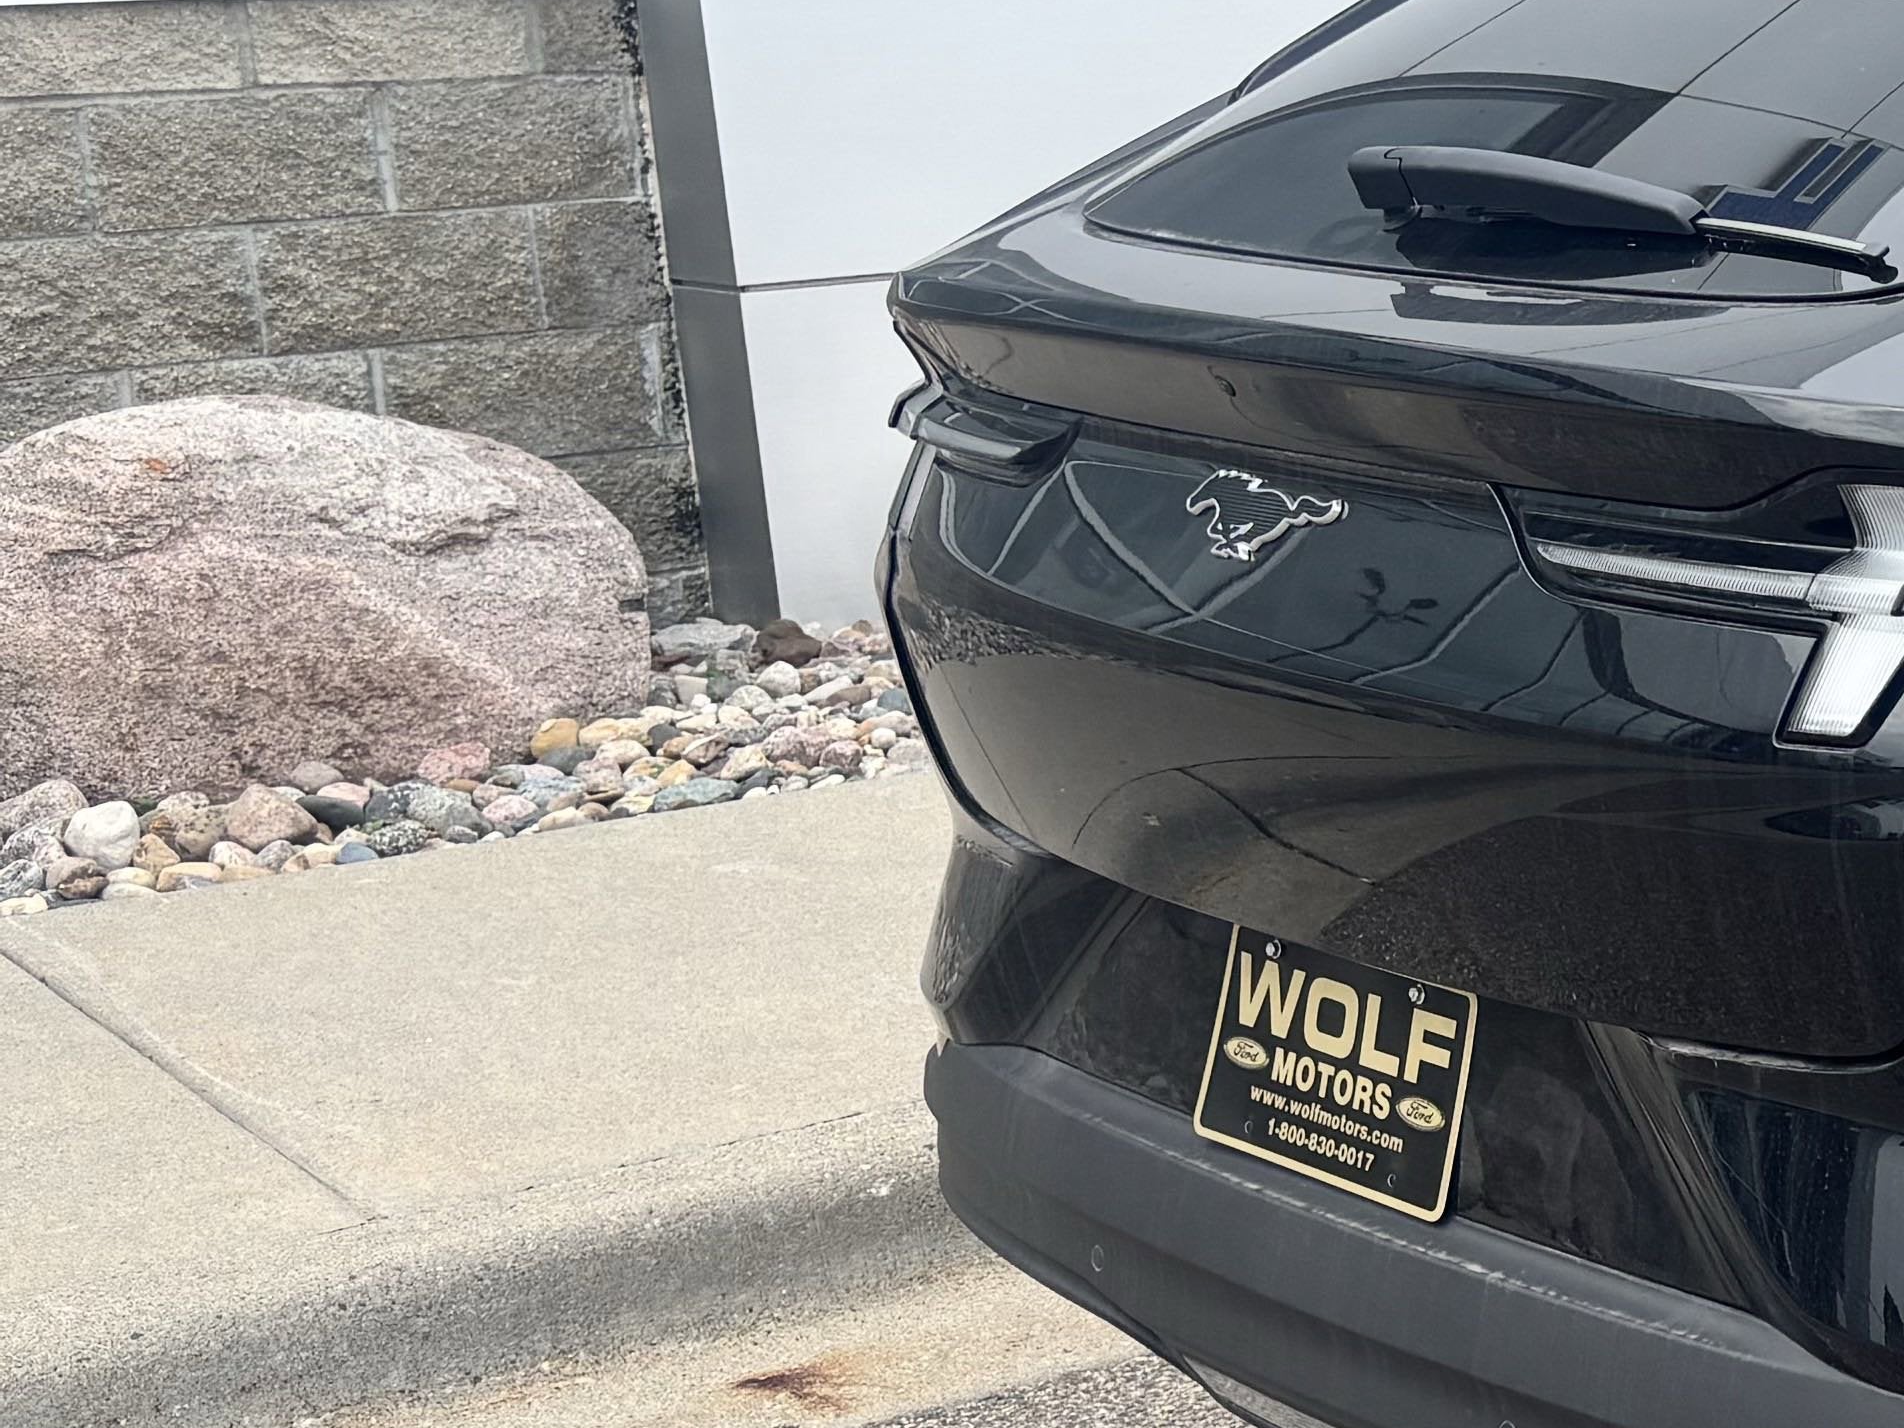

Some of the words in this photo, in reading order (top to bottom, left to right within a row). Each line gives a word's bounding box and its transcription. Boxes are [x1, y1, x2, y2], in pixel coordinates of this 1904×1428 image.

[1239, 950, 1458, 1084] WOLF
[1270, 1047, 1394, 1120] MOTORS
[1249, 1085, 1404, 1154] www.wolfmotors.com
[1266, 1117, 1376, 1172] 1-800-830-0017
